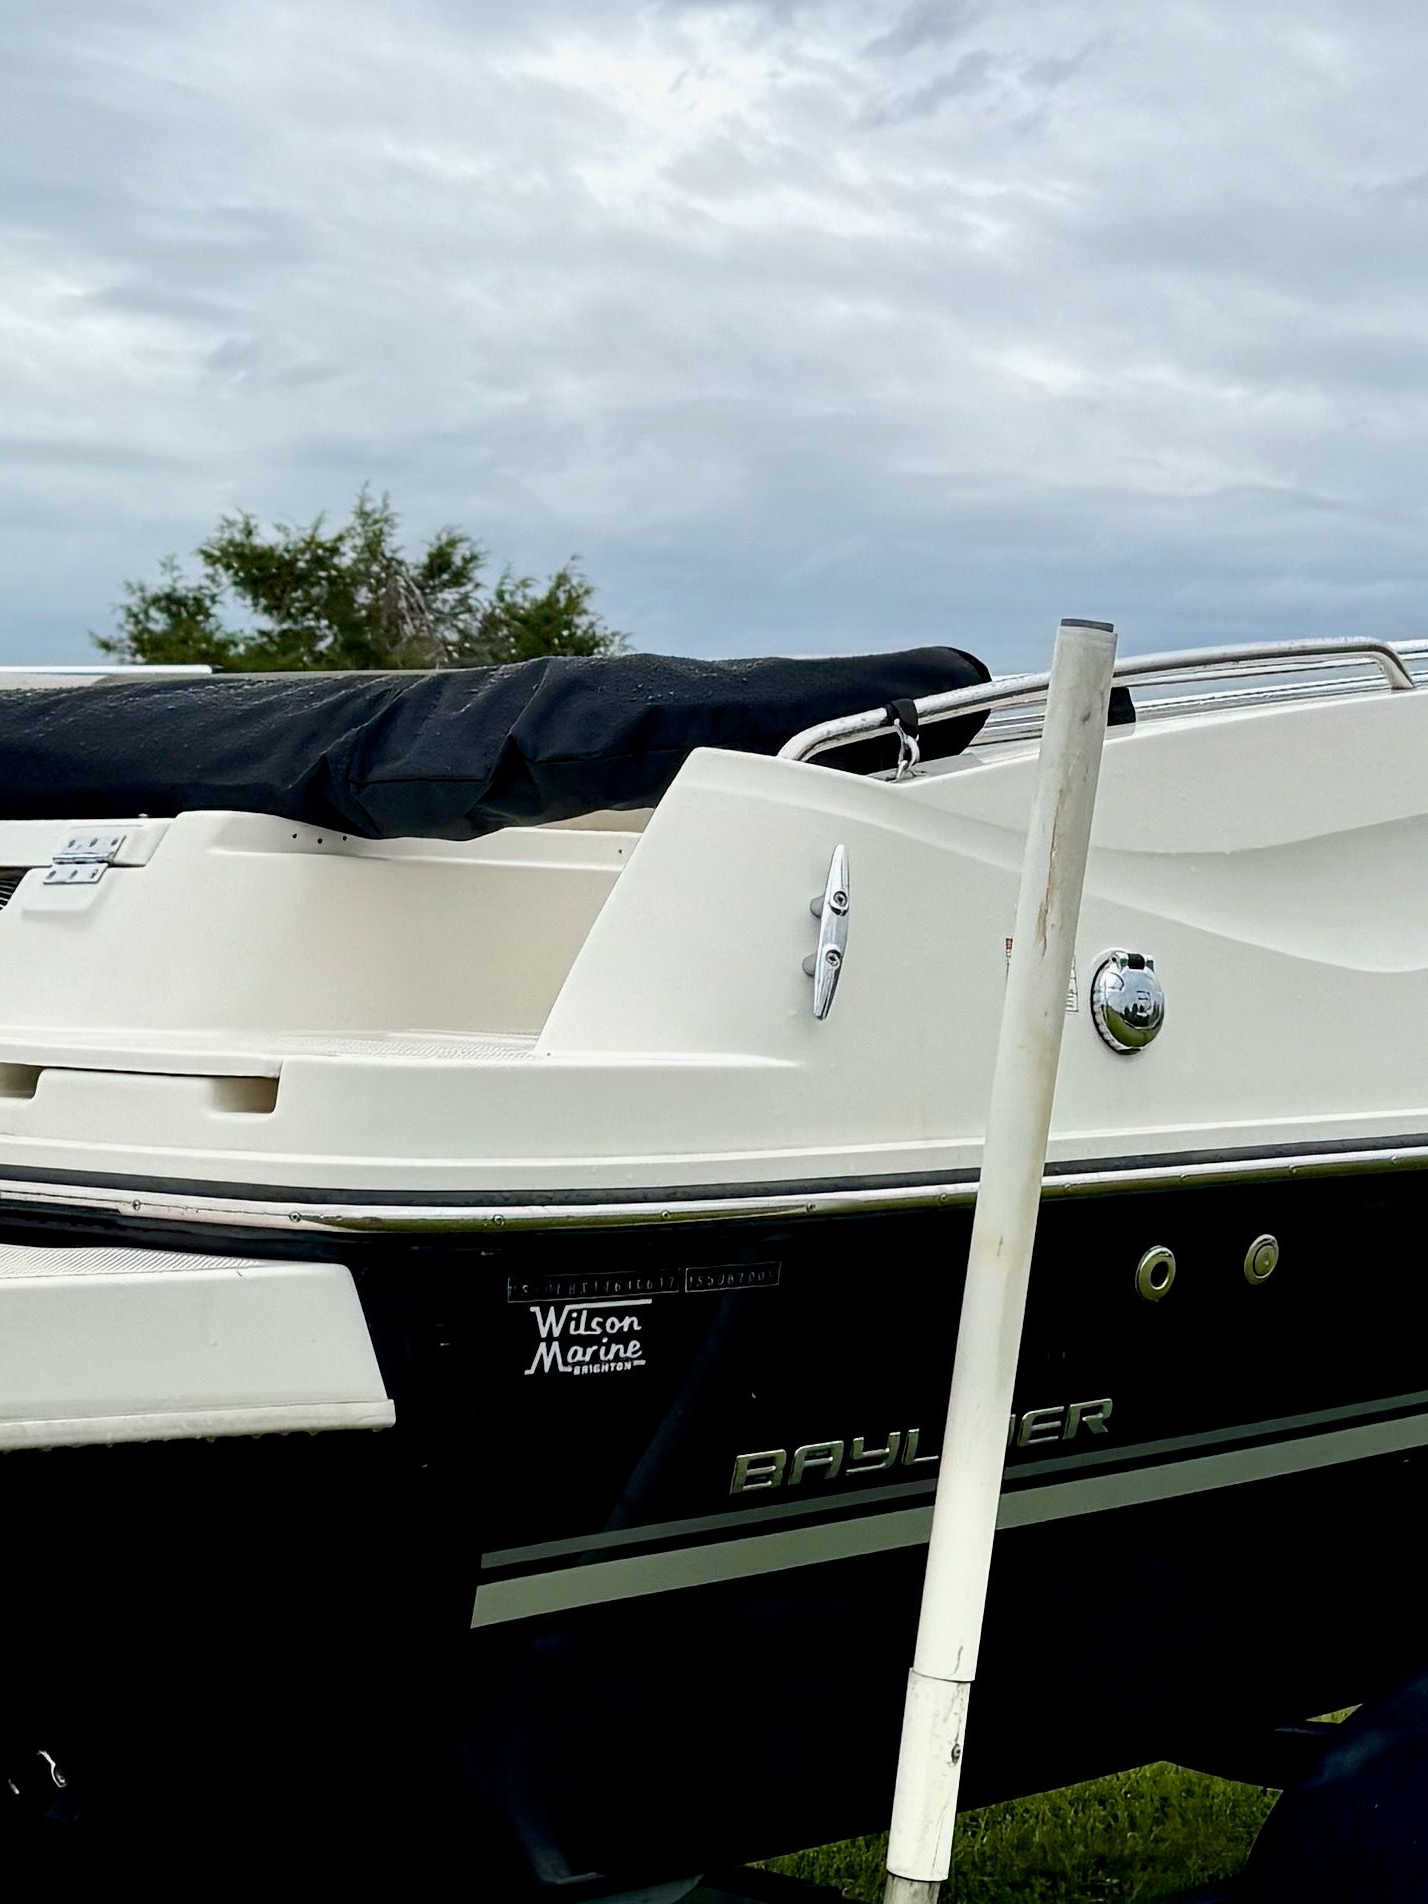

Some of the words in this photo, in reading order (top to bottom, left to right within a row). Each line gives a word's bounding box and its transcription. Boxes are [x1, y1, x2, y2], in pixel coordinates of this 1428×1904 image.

[530, 1301, 644, 1338] Wilson
[524, 1337, 644, 1375] Marine
[573, 1361, 633, 1375] BRIGHTON
[729, 1398, 1113, 1495] BAYLER
